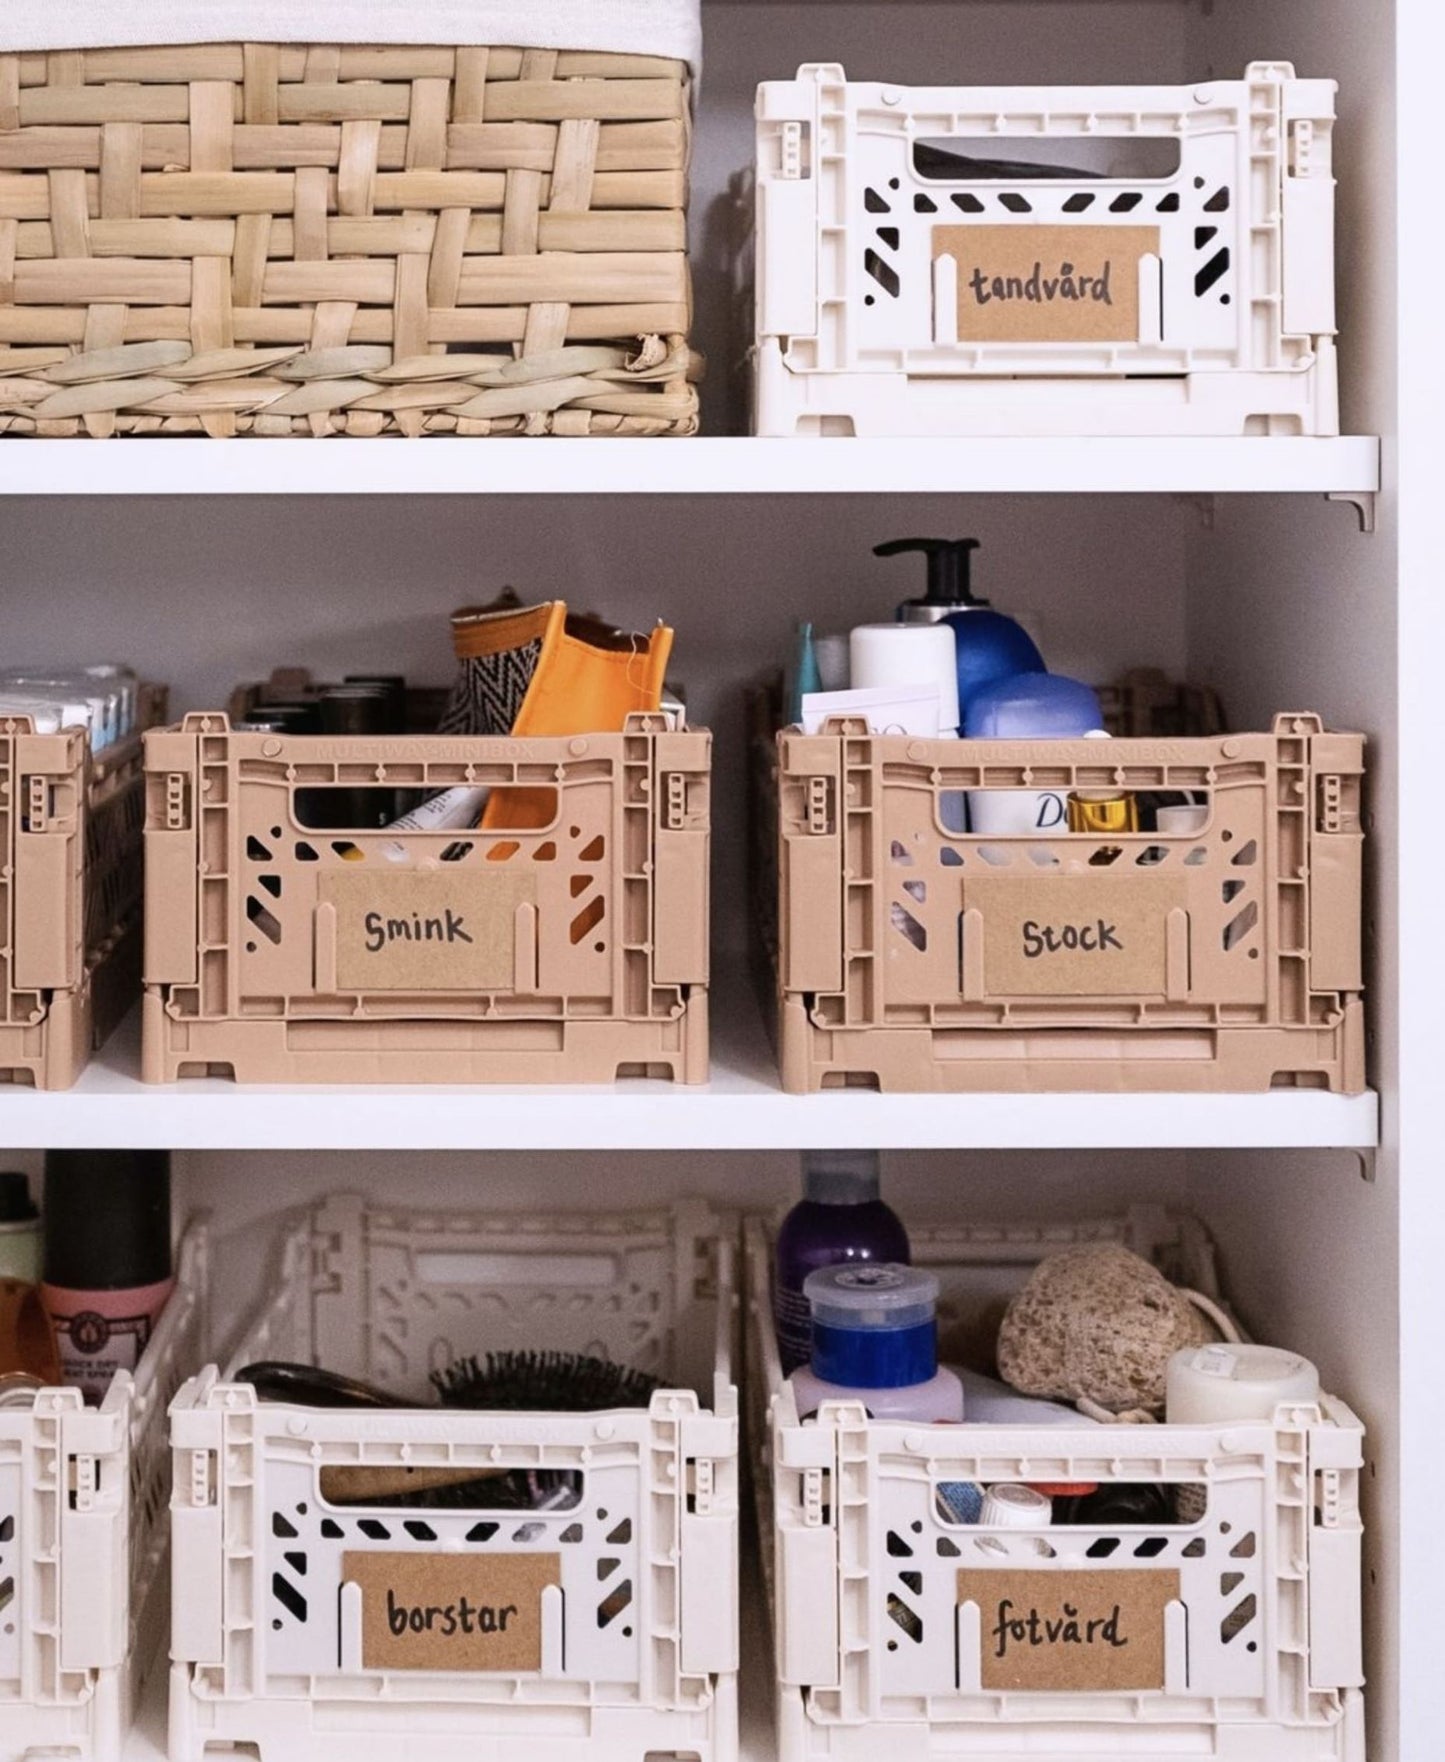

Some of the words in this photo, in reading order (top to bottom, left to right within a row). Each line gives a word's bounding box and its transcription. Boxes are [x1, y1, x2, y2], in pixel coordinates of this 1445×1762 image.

[969, 260, 1113, 305] tandvård
[1035, 792, 1067, 828] D
[365, 908, 474, 952] Smink
[1023, 919, 1124, 958] Stock
[387, 1589, 518, 1637] borstar
[992, 1599, 1128, 1658] fotvård
